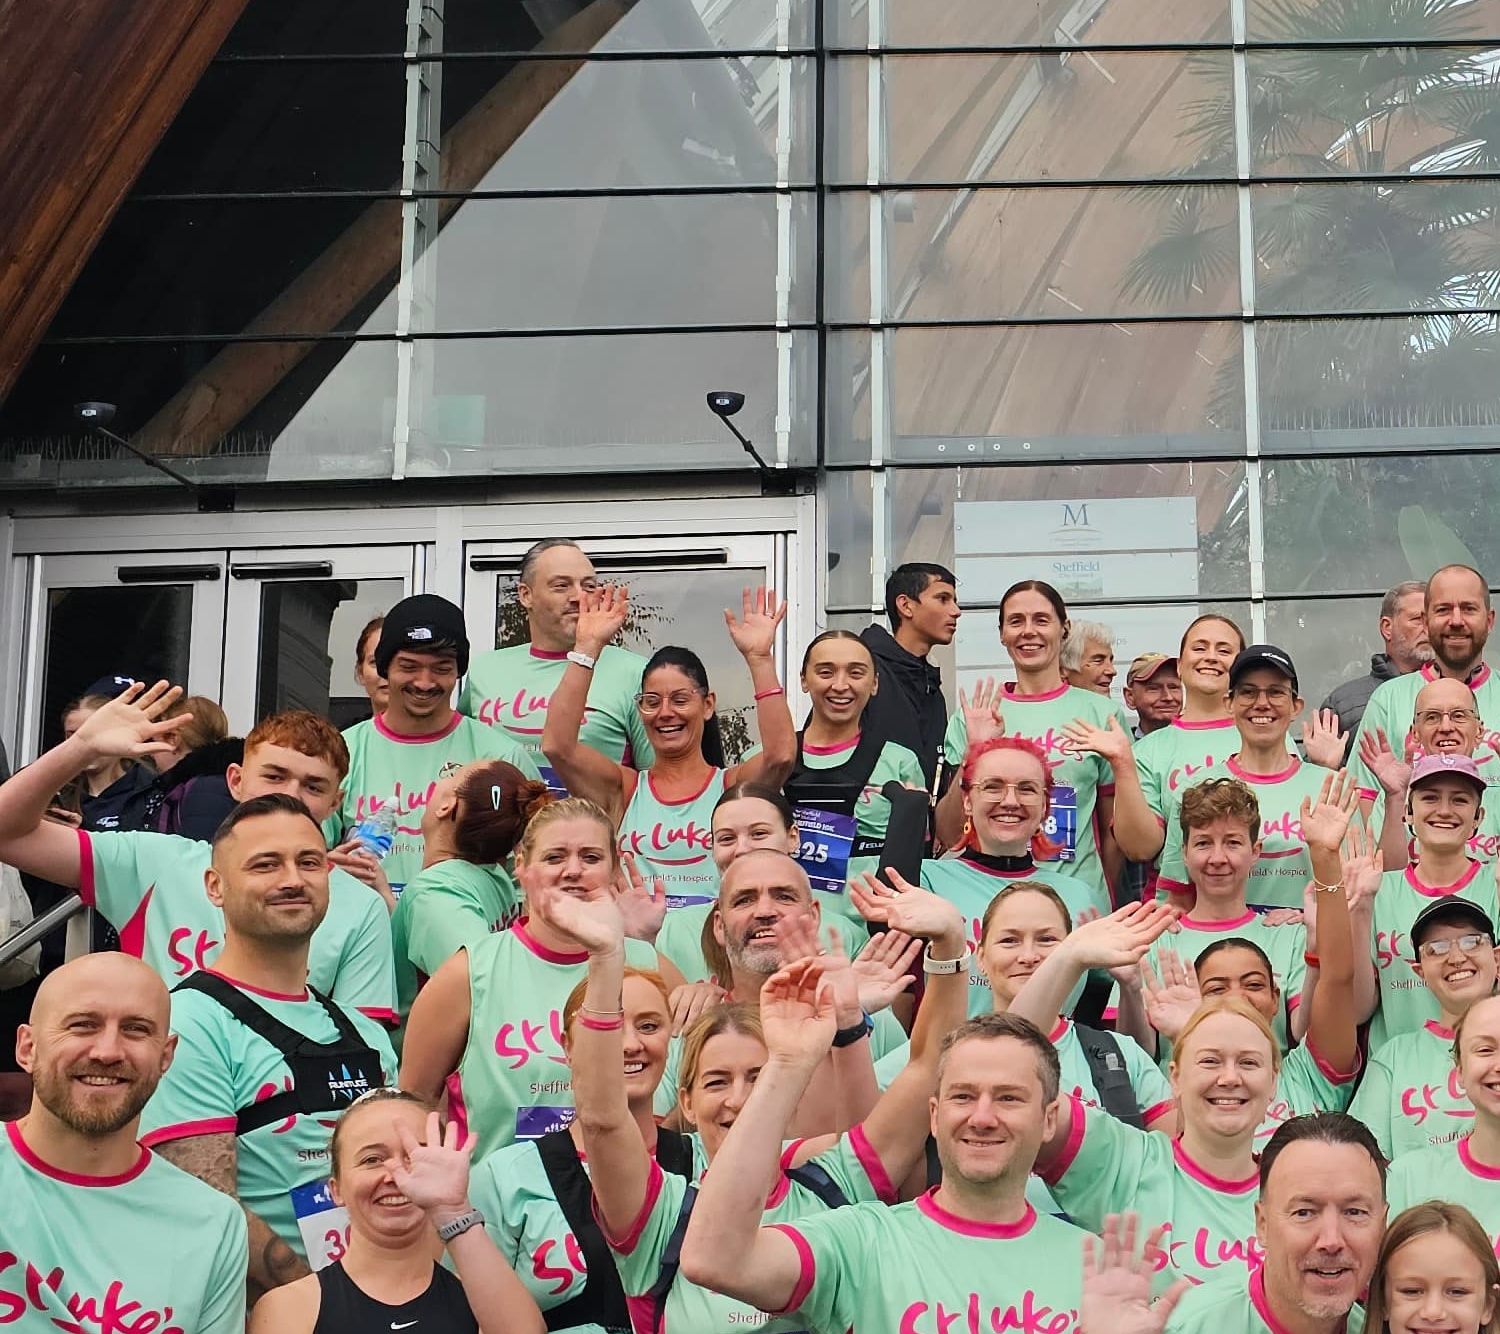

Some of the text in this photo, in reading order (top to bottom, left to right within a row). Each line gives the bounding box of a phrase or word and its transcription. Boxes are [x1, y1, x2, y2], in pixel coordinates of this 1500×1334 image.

[1062, 503, 1088, 525] M
[652, 821, 714, 851] Luke
[1275, 868, 1308, 878] Hospice
[494, 1019, 545, 1069] St
[1402, 1084, 1442, 1126] St
